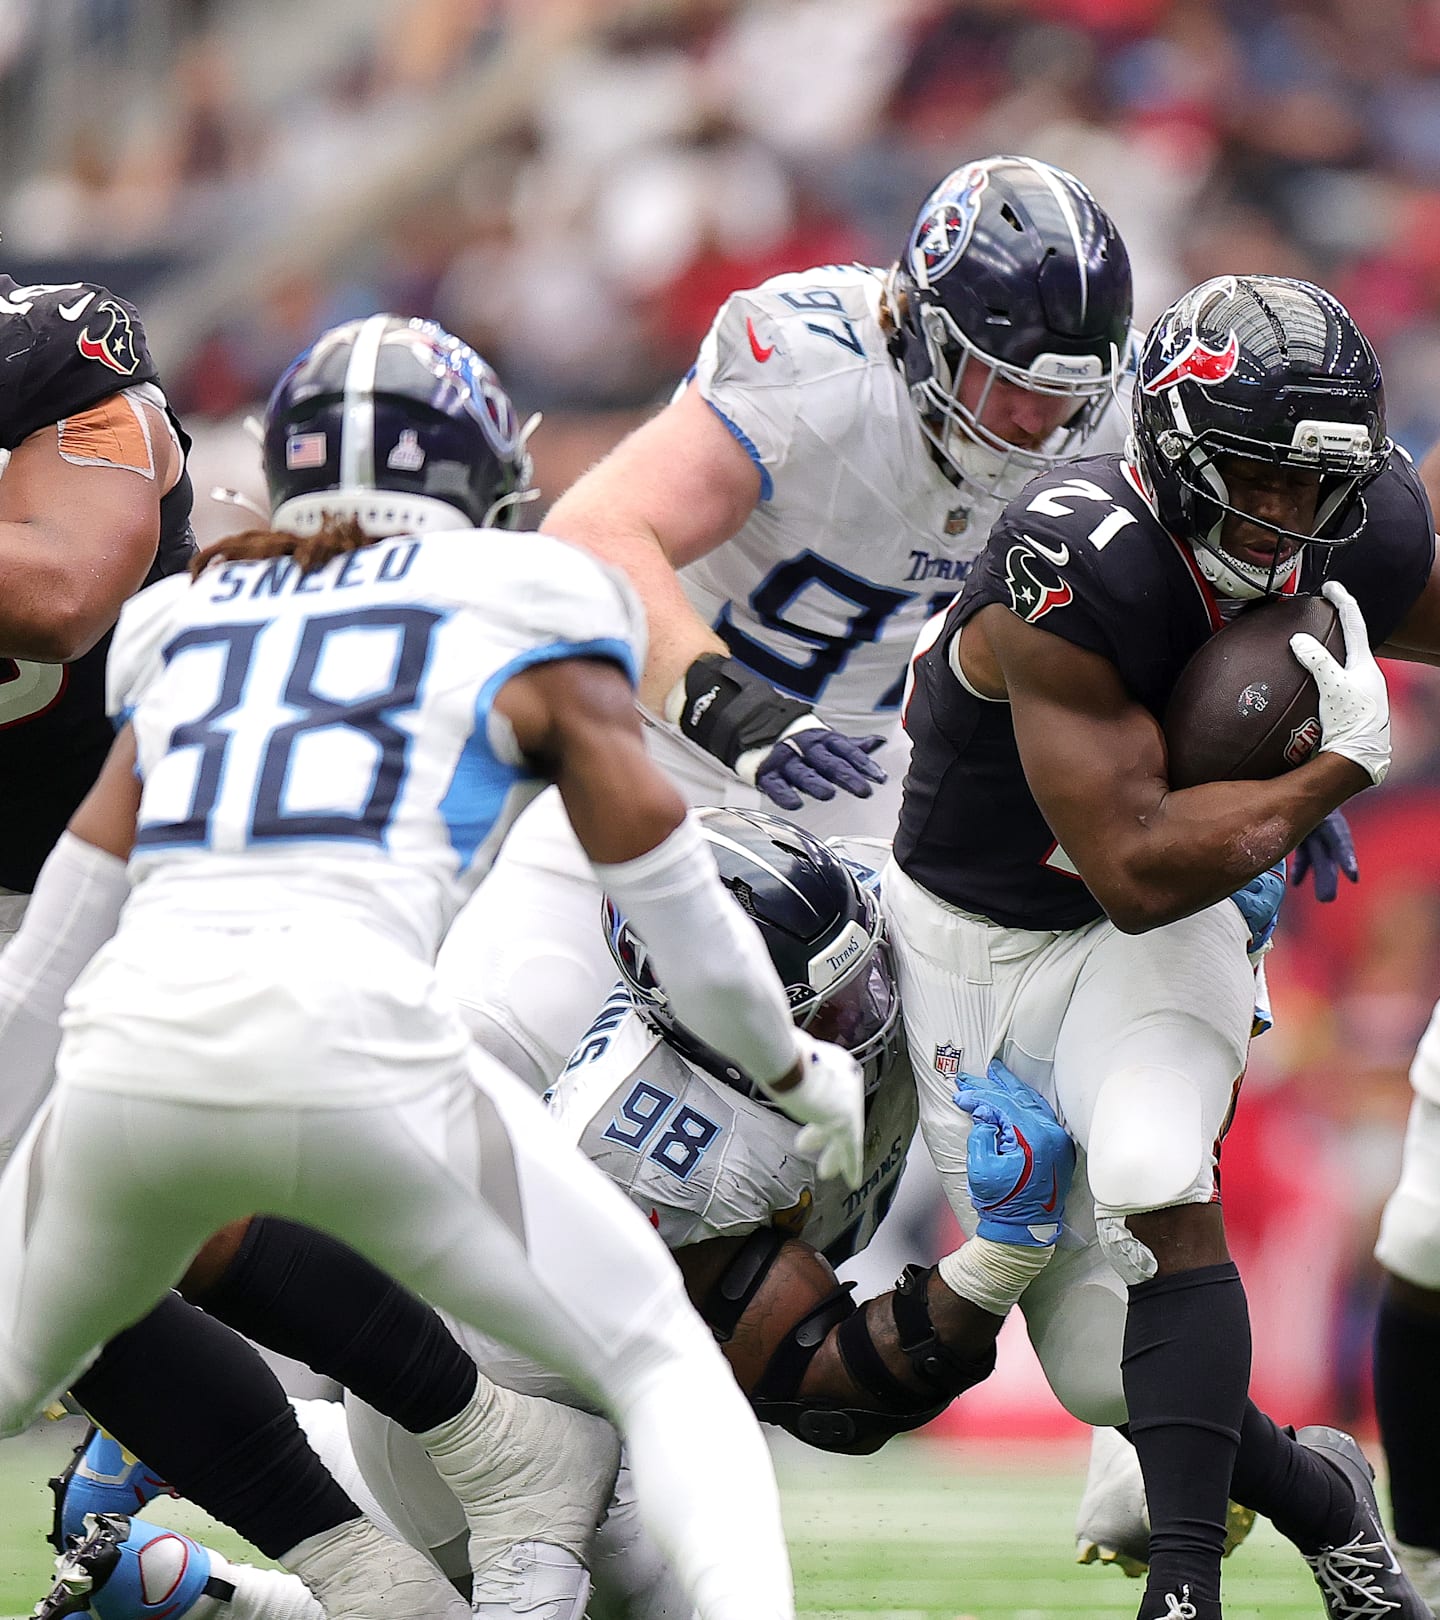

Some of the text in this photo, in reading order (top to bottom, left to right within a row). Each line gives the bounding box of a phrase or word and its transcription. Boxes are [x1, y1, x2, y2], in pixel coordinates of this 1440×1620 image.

[777, 287, 868, 361] 97
[1024, 478, 1140, 553] 21
[903, 549, 976, 582] TITAN
[133, 602, 457, 854] 38
[826, 935, 860, 971] TITANS
[936, 1056, 957, 1073] NFL
[601, 1078, 724, 1185] 98
[841, 1135, 902, 1221] TITANS
